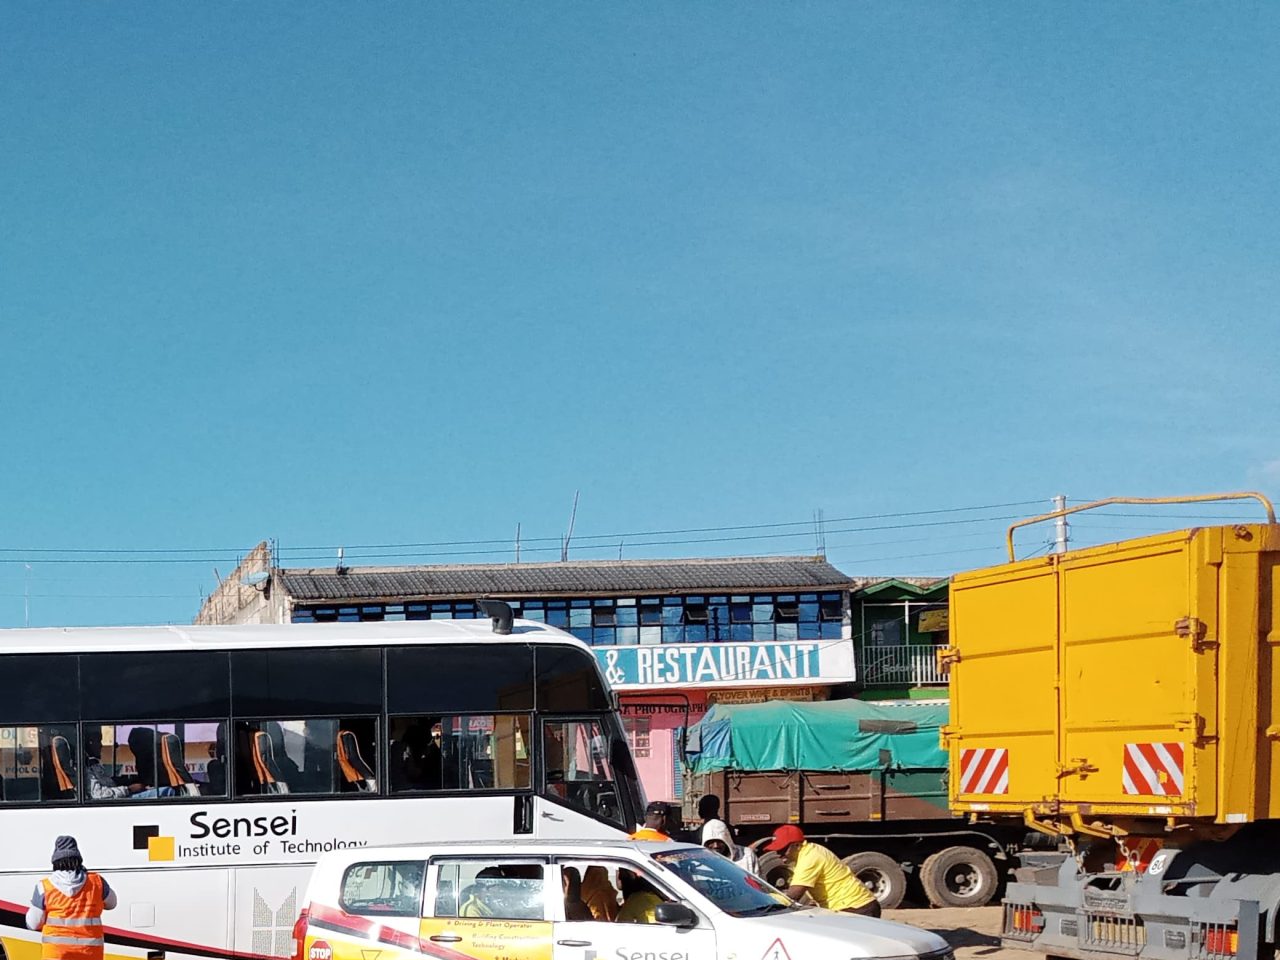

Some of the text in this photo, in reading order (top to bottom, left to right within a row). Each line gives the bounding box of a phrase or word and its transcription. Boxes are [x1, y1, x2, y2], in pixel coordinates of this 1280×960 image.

[605, 645, 814, 684] & RESTAURANT
[189, 809, 297, 839] Sensei
[178, 842, 241, 858] Institute
[253, 840, 270, 855] of
[310, 947, 331, 960] STOP
